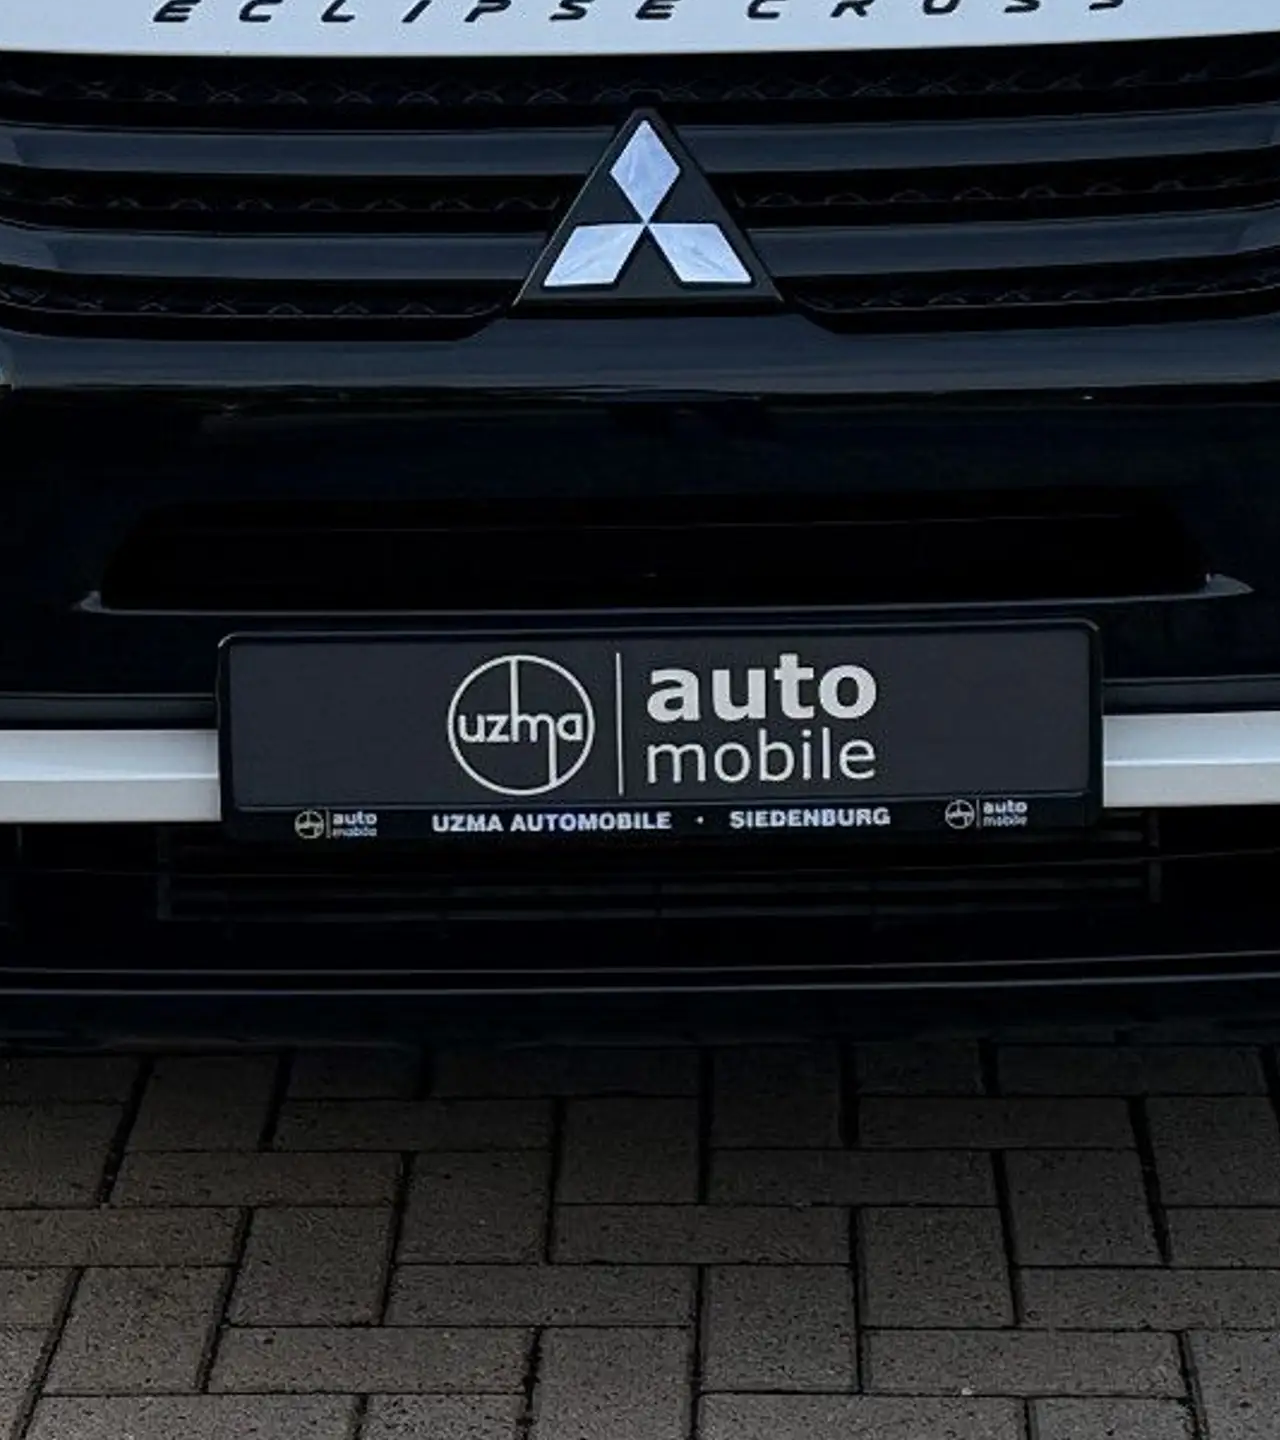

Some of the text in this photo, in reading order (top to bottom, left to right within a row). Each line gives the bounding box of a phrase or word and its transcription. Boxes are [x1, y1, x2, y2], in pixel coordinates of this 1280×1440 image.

[646, 653, 877, 721] auto
[647, 727, 877, 784] mobile
[332, 810, 378, 825] auto
[983, 800, 1028, 814] auto
[431, 808, 891, 832] UZMA AUTOMOBILE SIEDENBURG
